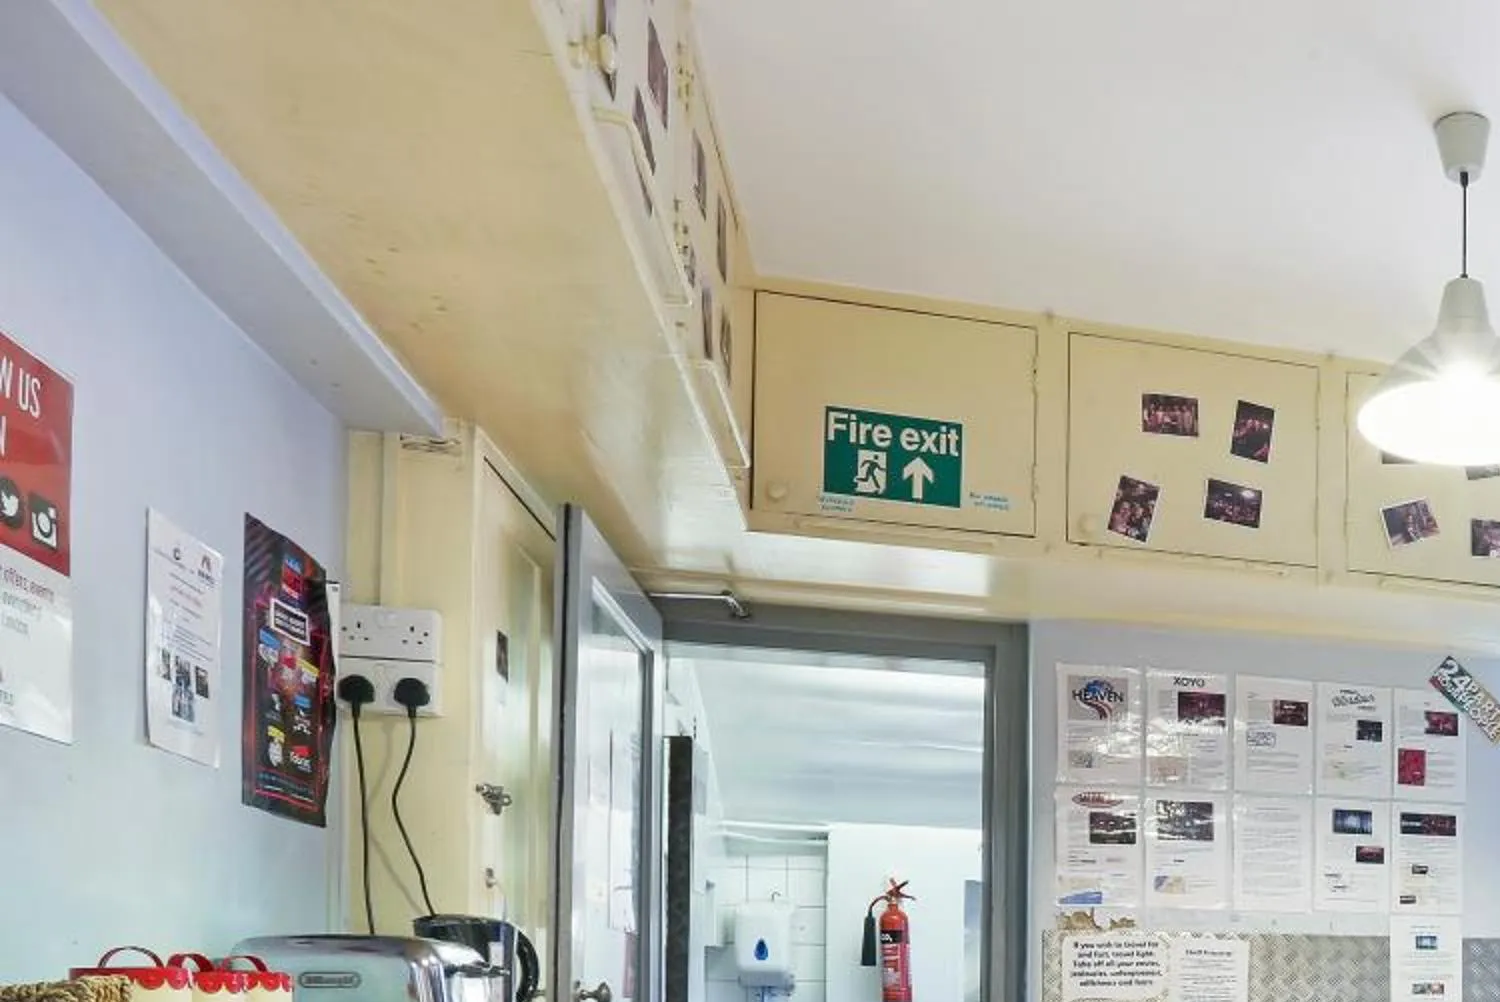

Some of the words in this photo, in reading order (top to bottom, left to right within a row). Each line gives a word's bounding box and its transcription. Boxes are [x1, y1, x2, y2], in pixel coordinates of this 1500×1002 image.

[19, 367, 41, 419] US
[827, 411, 893, 448] Fire
[900, 426, 960, 457] exit
[1072, 689, 1124, 702] HEAVEN
[1173, 676, 1205, 688] XOYO
